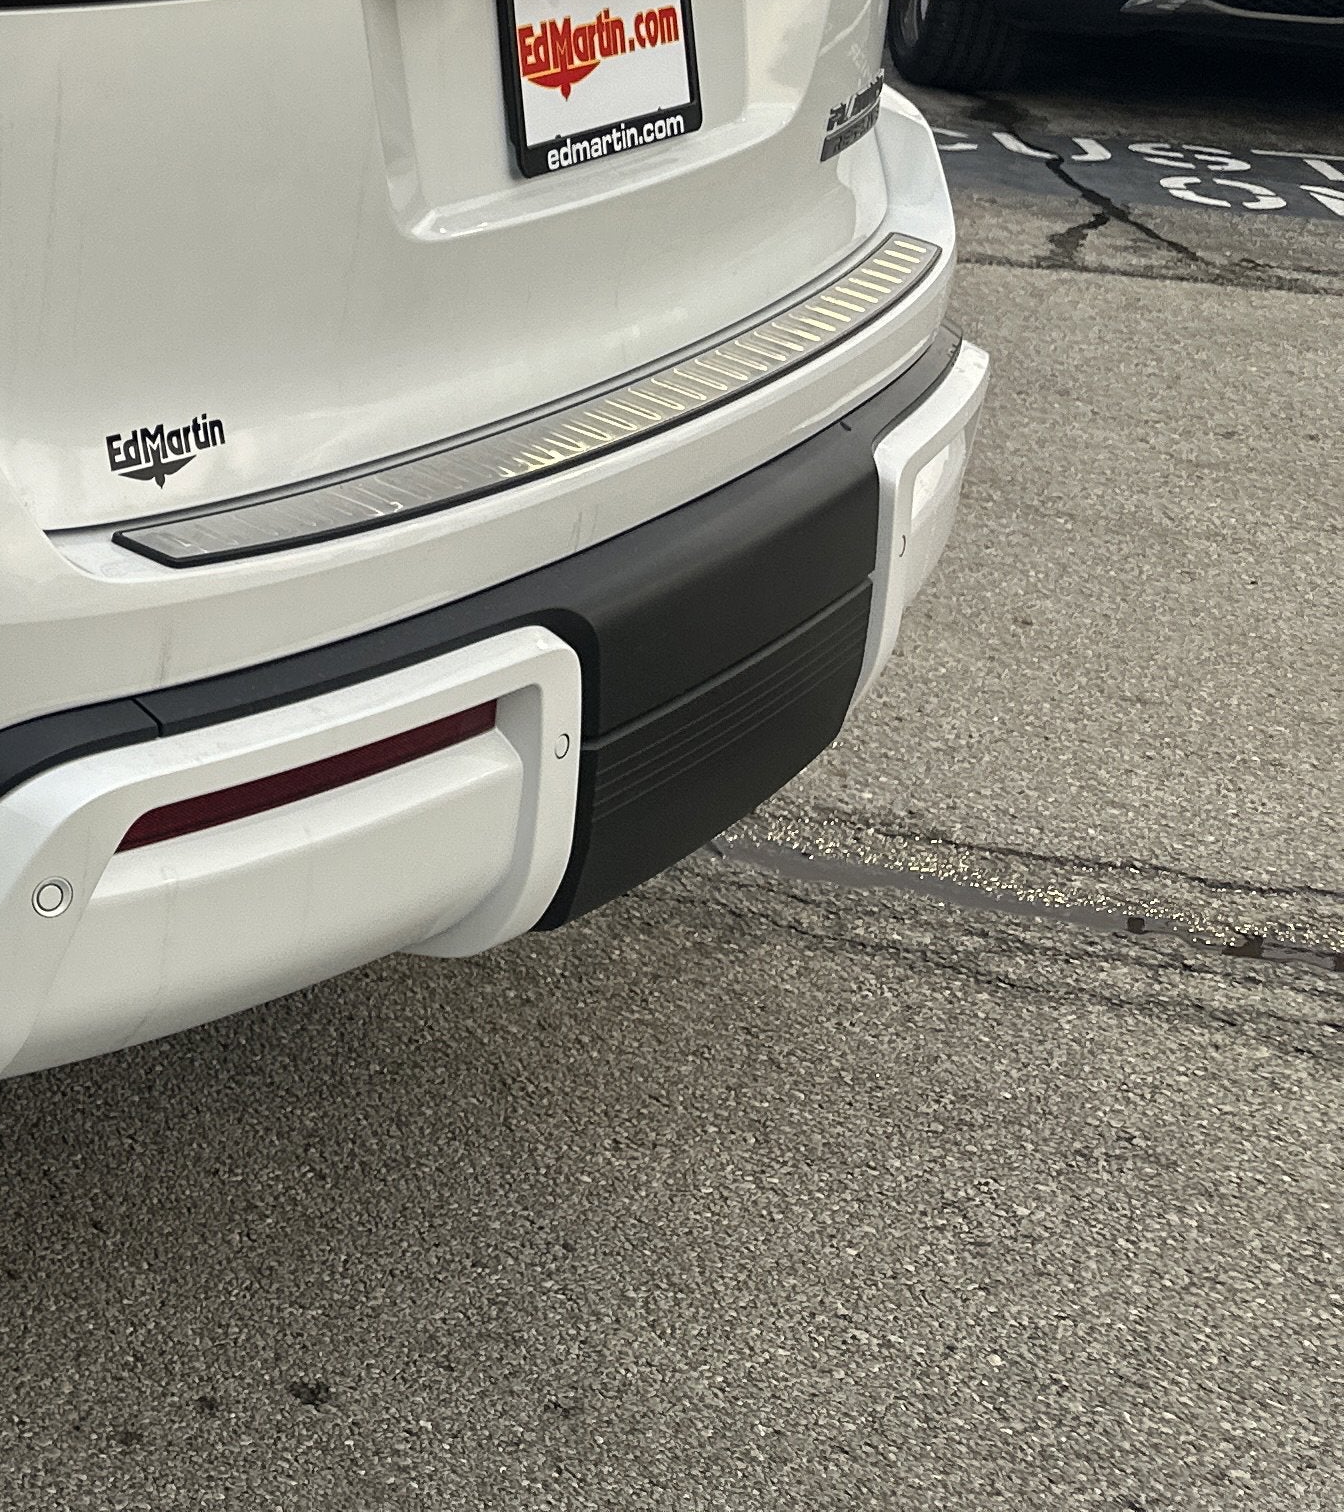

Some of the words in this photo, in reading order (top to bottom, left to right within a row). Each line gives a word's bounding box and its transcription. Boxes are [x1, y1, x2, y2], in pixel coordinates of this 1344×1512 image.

[517, 5, 680, 78] EdMartin.com
[547, 114, 685, 171] edmartin.com
[105, 413, 226, 472] EdMartin
